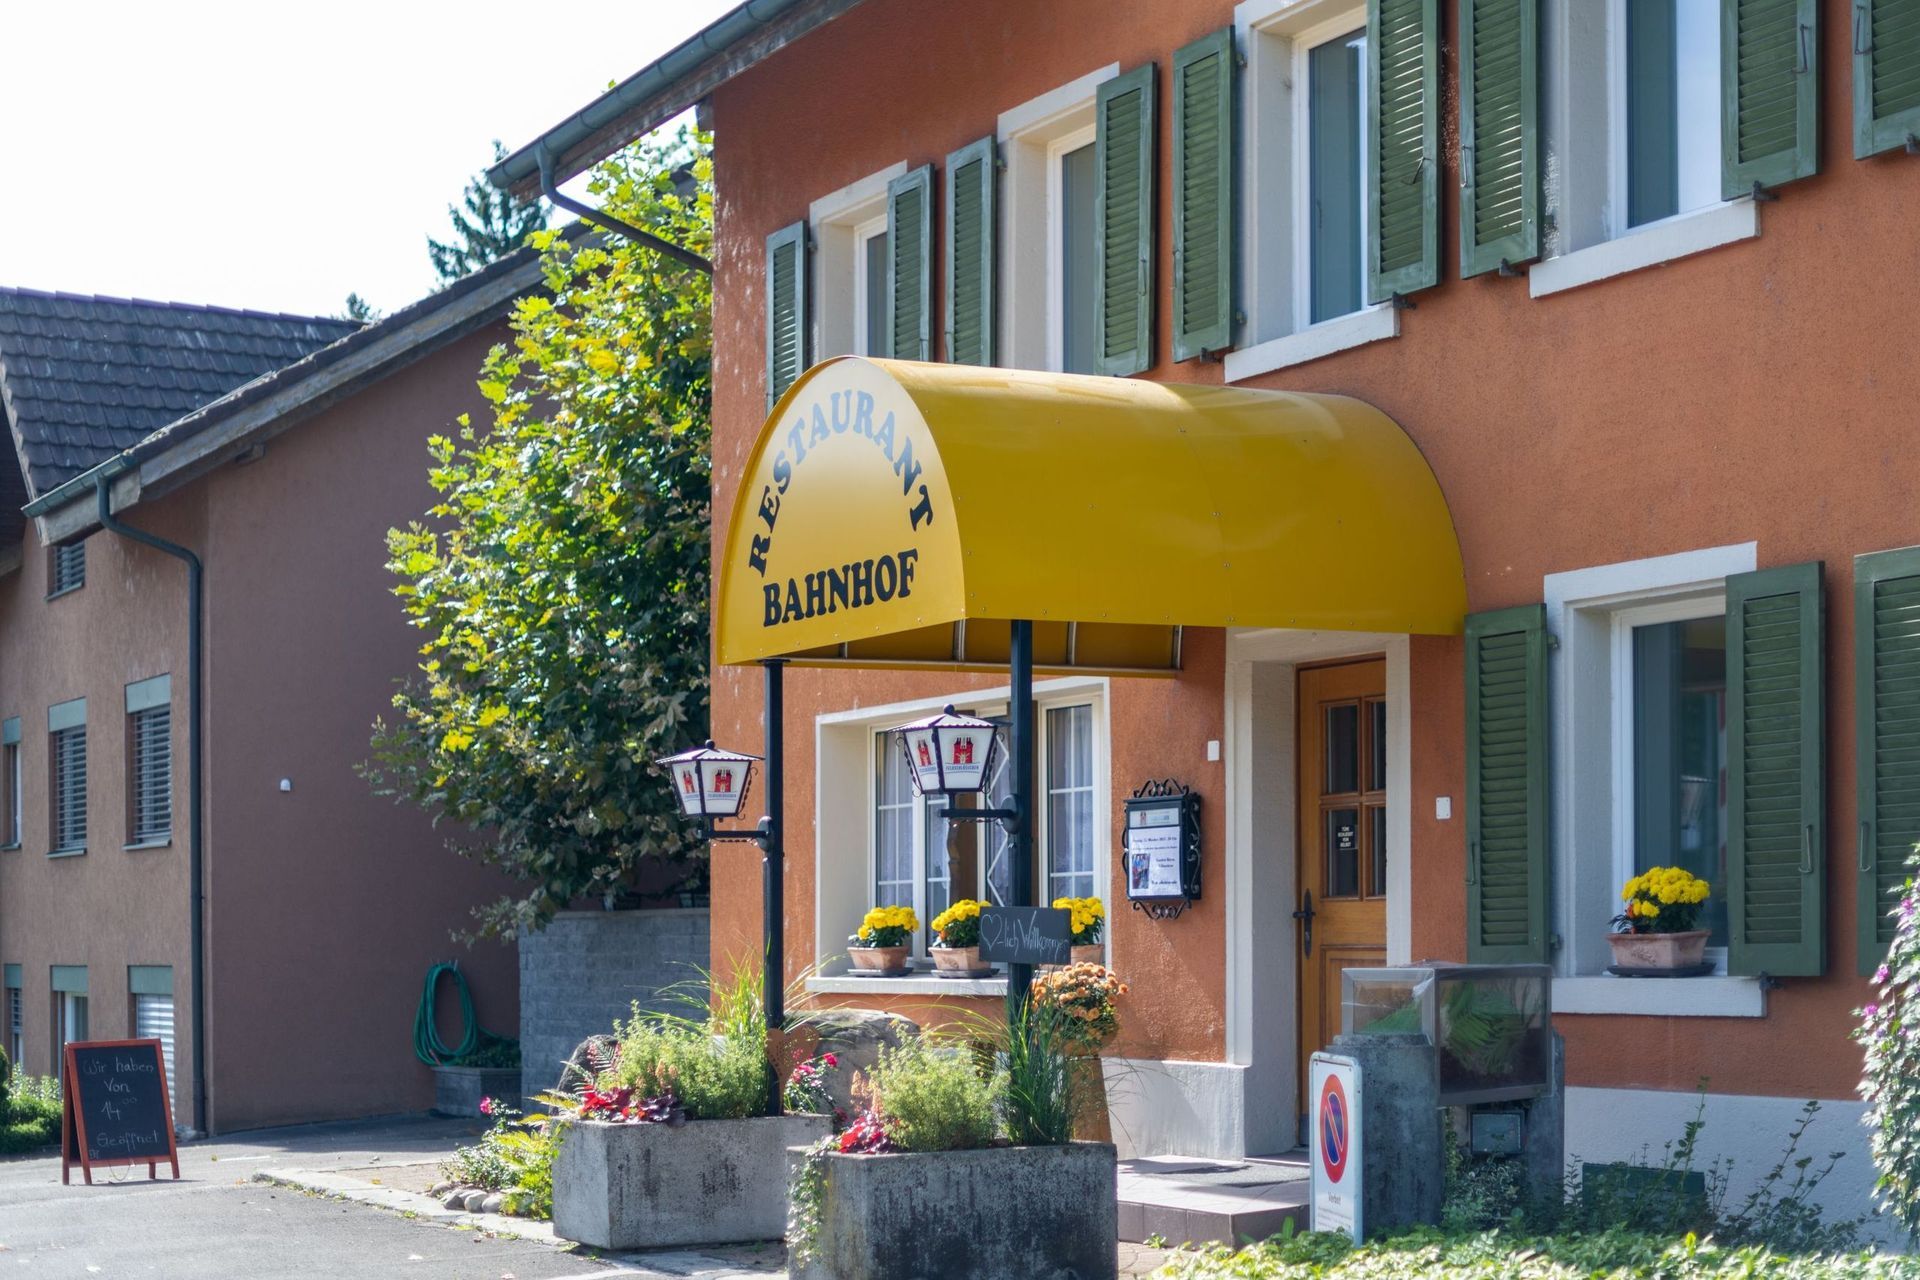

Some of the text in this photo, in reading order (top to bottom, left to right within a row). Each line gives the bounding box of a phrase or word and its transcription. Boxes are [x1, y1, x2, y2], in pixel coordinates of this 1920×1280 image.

[749, 389, 934, 578] RESTAURANT
[763, 548, 919, 628] BAHNHOF
[83, 1056, 154, 1075] Wir haben
